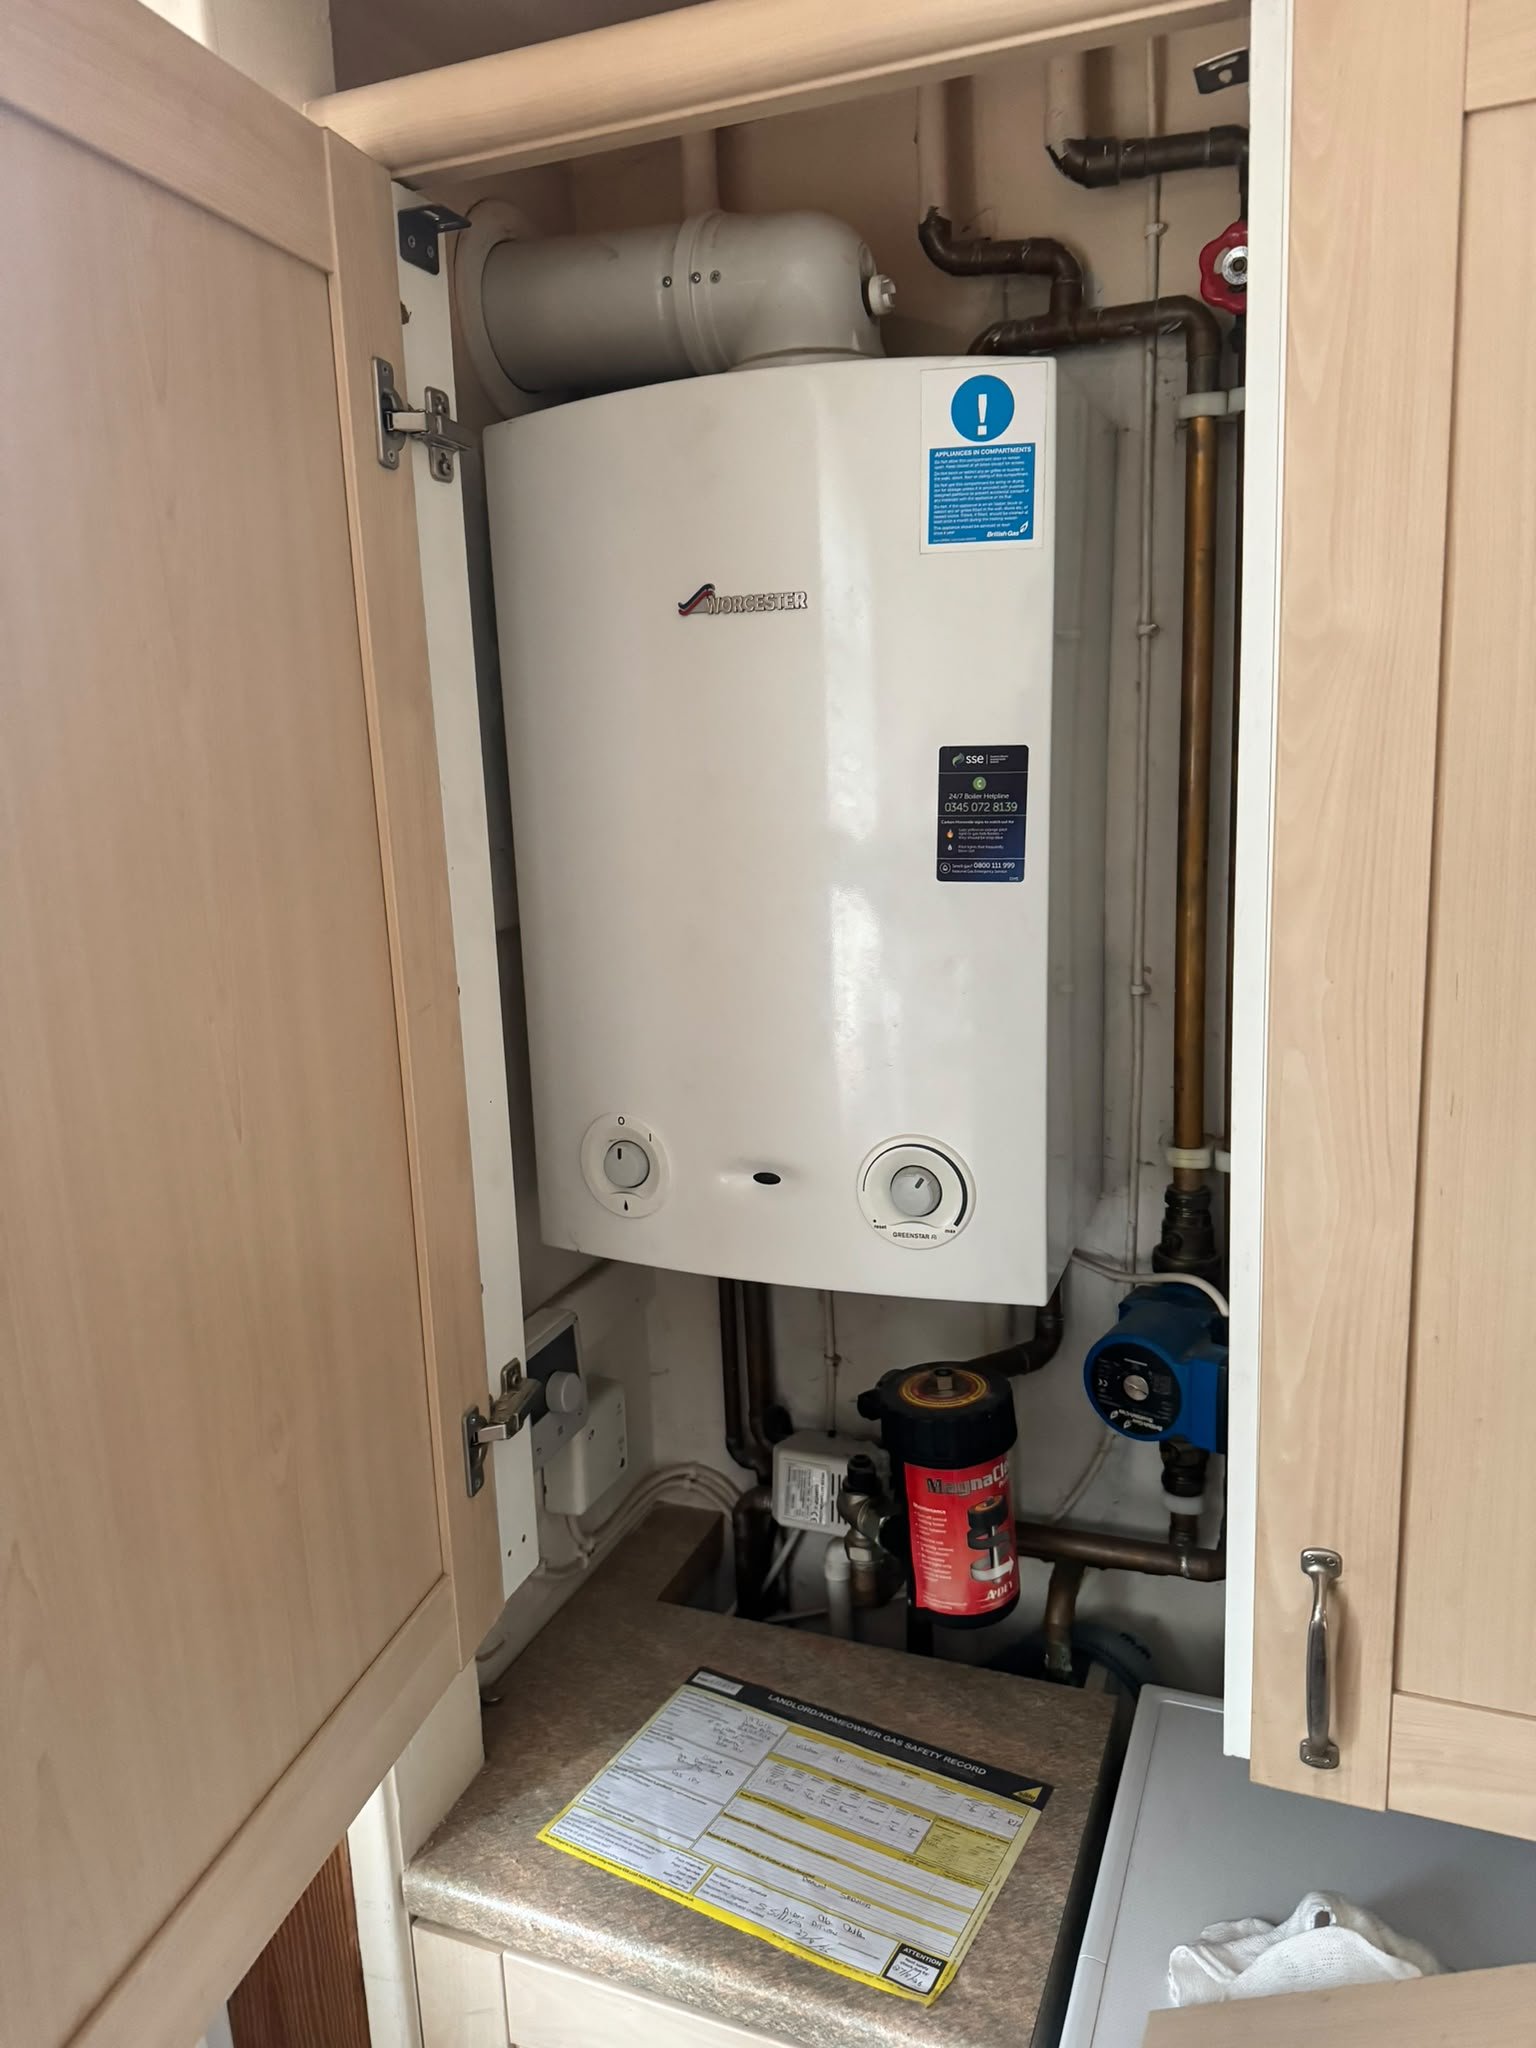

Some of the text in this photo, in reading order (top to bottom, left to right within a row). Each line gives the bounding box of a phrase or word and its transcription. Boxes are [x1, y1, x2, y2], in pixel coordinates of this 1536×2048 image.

[980, 446, 1032, 455] COMPARTMENTS
[706, 591, 808, 615] WORCESTER
[966, 755, 984, 764] sse
[944, 802, 1018, 812] 0345 072 8139
[768, 1694, 881, 1738] LANDLORD/HOMEOWNER
[883, 1734, 902, 1747] GAS
[904, 1742, 942, 1760] SAFETY
[943, 1756, 987, 1775] RECORD
[904, 1947, 942, 1966] ATTENTION
